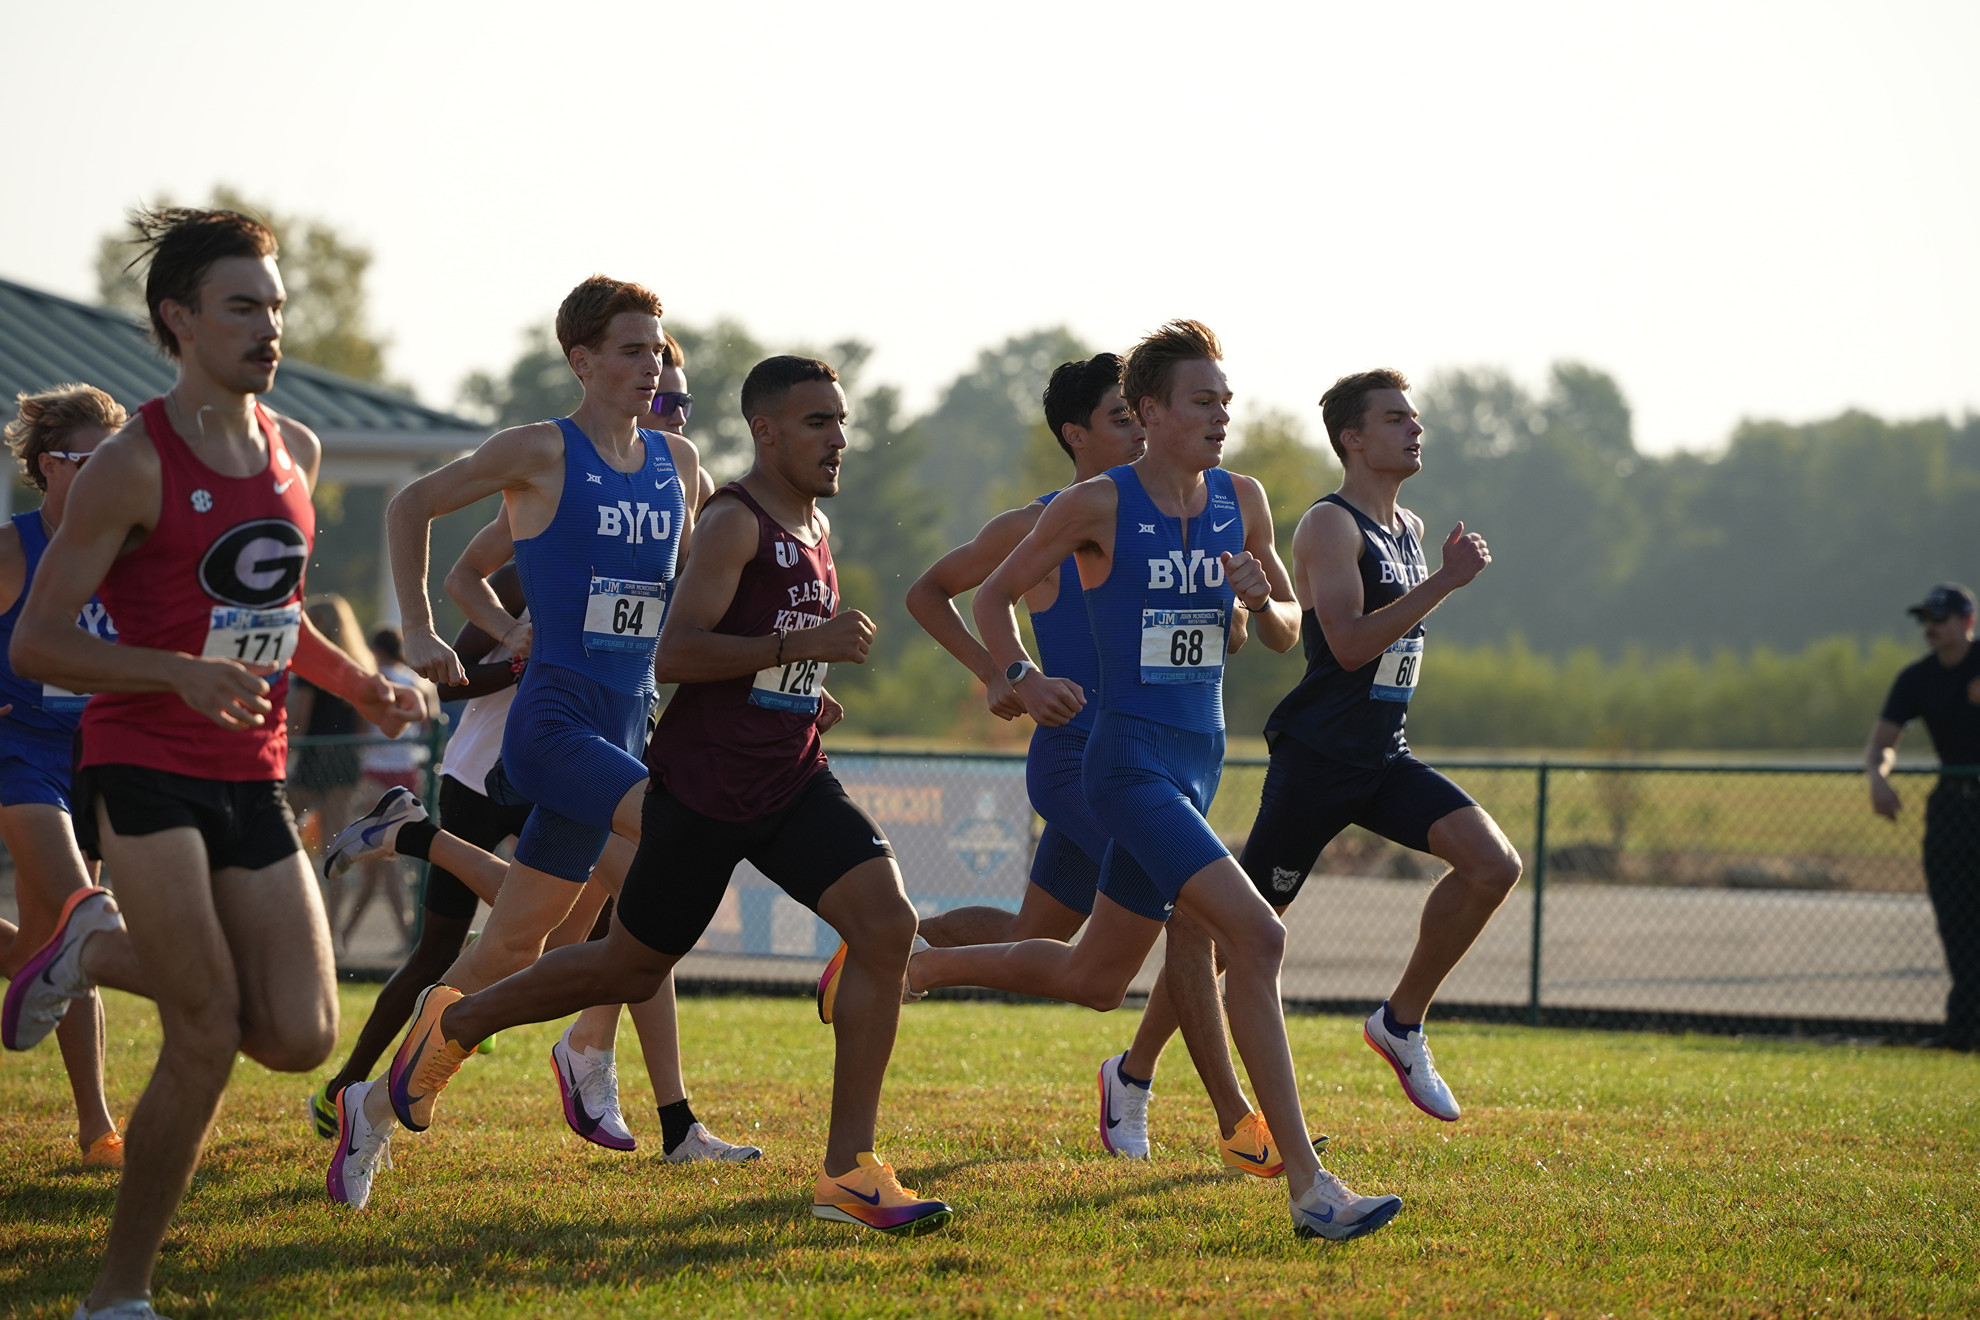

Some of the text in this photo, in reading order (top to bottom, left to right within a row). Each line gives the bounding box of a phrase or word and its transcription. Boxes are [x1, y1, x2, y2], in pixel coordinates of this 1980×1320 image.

[597, 500, 671, 544] BYU
[200, 520, 307, 608] G
[1147, 549, 1225, 594] BYU
[605, 581, 620, 593] JM
[612, 598, 645, 635] 64
[1158, 613, 1176, 625] JM
[234, 631, 285, 662] 171
[1170, 629, 1204, 666] 68
[1395, 641, 1407, 652] JM
[779, 659, 818, 696] 126
[1150, 672, 1186, 680] SEPTEMBER
[1395, 655, 1417, 687] 60
